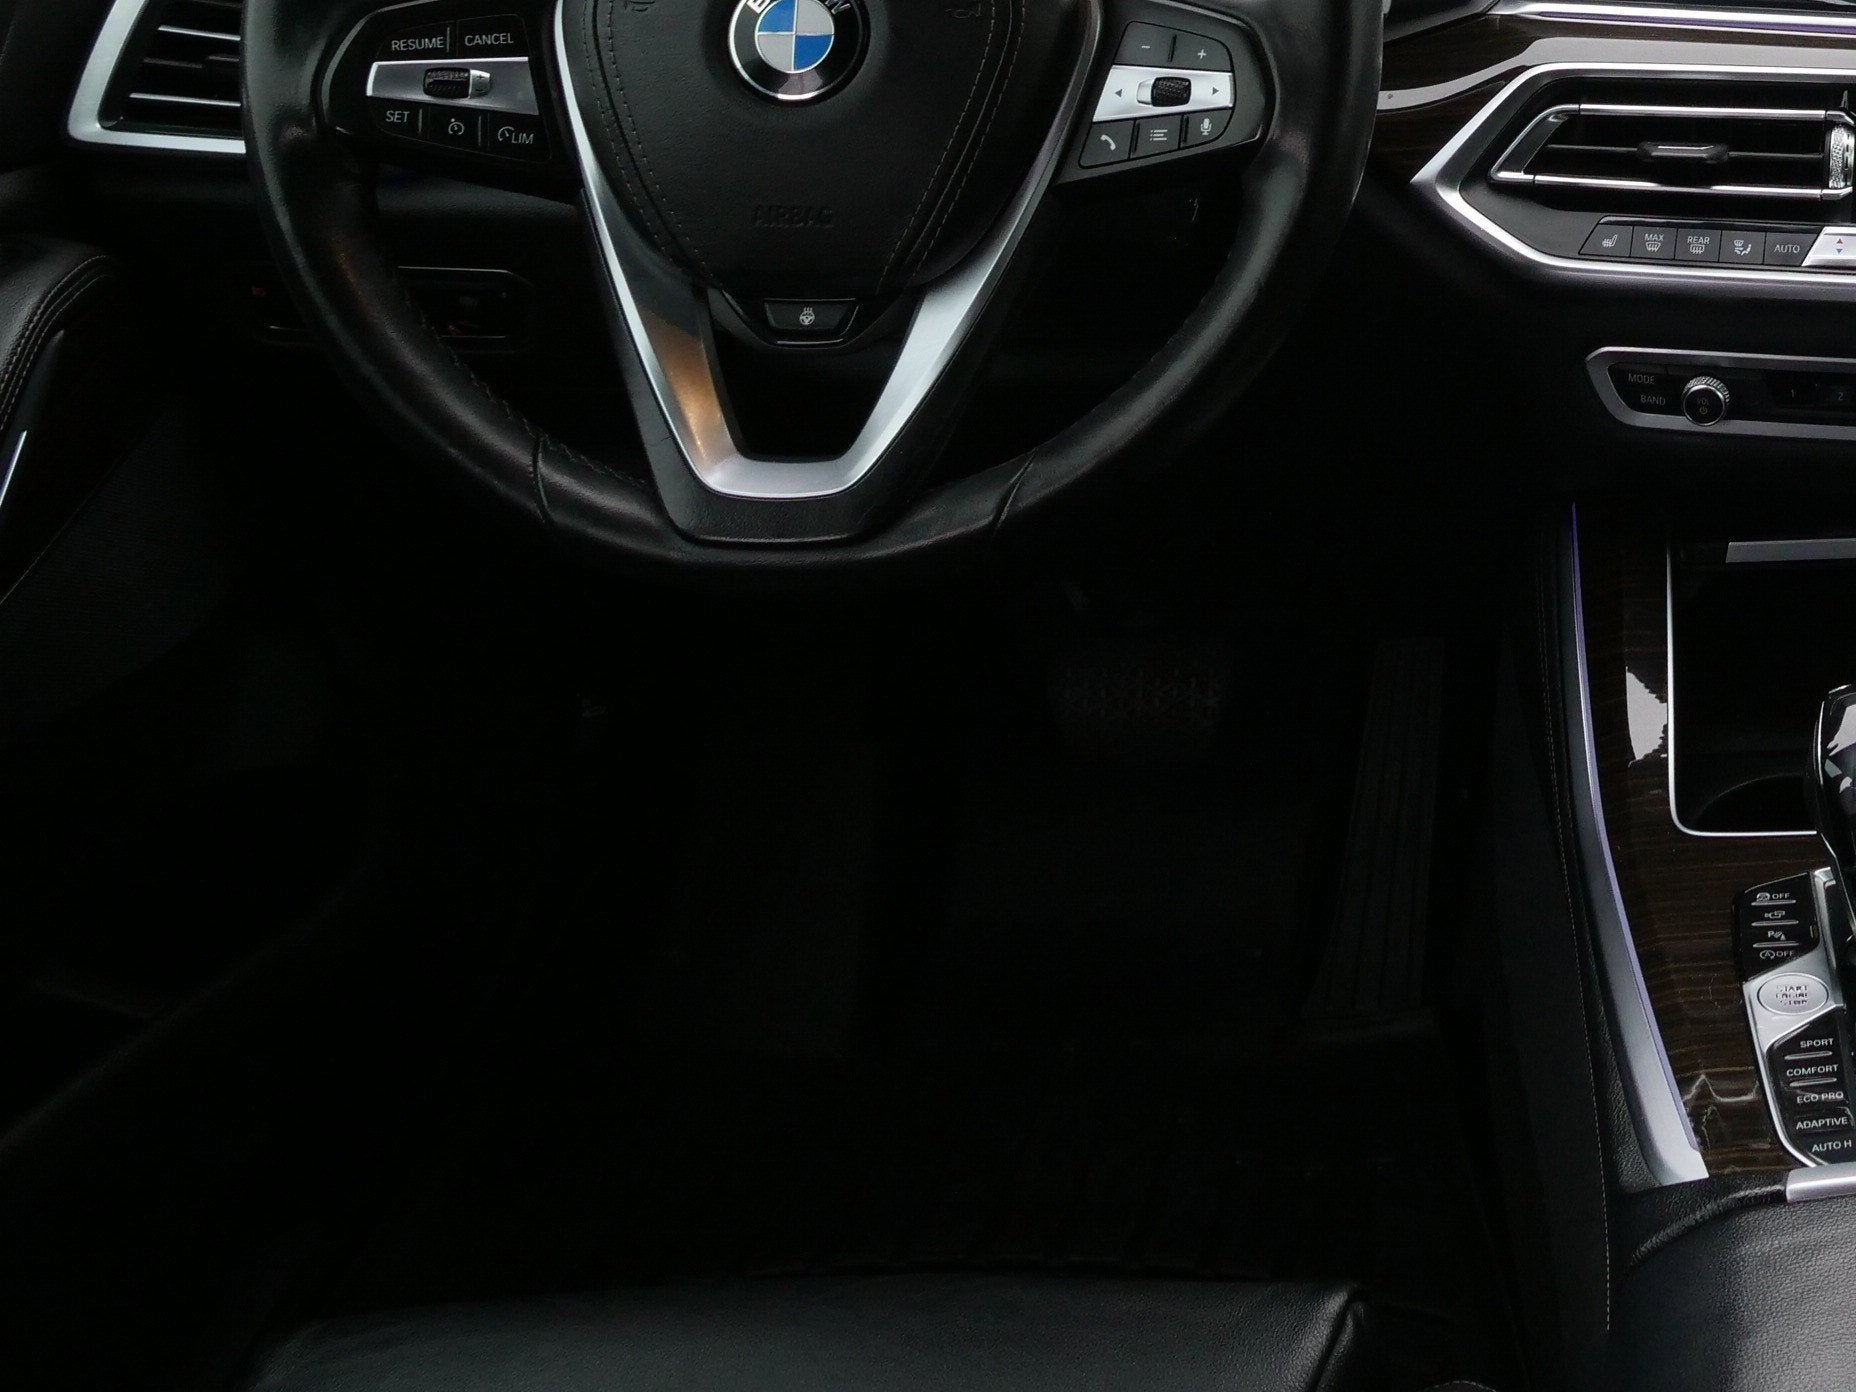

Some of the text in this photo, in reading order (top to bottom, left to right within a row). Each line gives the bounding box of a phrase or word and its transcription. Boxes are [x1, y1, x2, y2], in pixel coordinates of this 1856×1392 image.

[391, 33, 514, 51] RESUME CANCEL
[385, 110, 410, 123] SET
[511, 132, 534, 144] LIM
[1644, 233, 1664, 242] MAX
[1687, 236, 1710, 245] REAR
[1773, 244, 1801, 254] AUTO
[1628, 373, 1656, 384] MODE
[1640, 394, 1666, 406] BAND
[1800, 1038, 1834, 1048] SPORT
[1786, 1064, 1839, 1077] COMFORT
[1796, 1091, 1844, 1104] ECO PRO
[1796, 1116, 1848, 1130] ADAPTIVE
[1811, 1139, 1852, 1153] AUTO H
